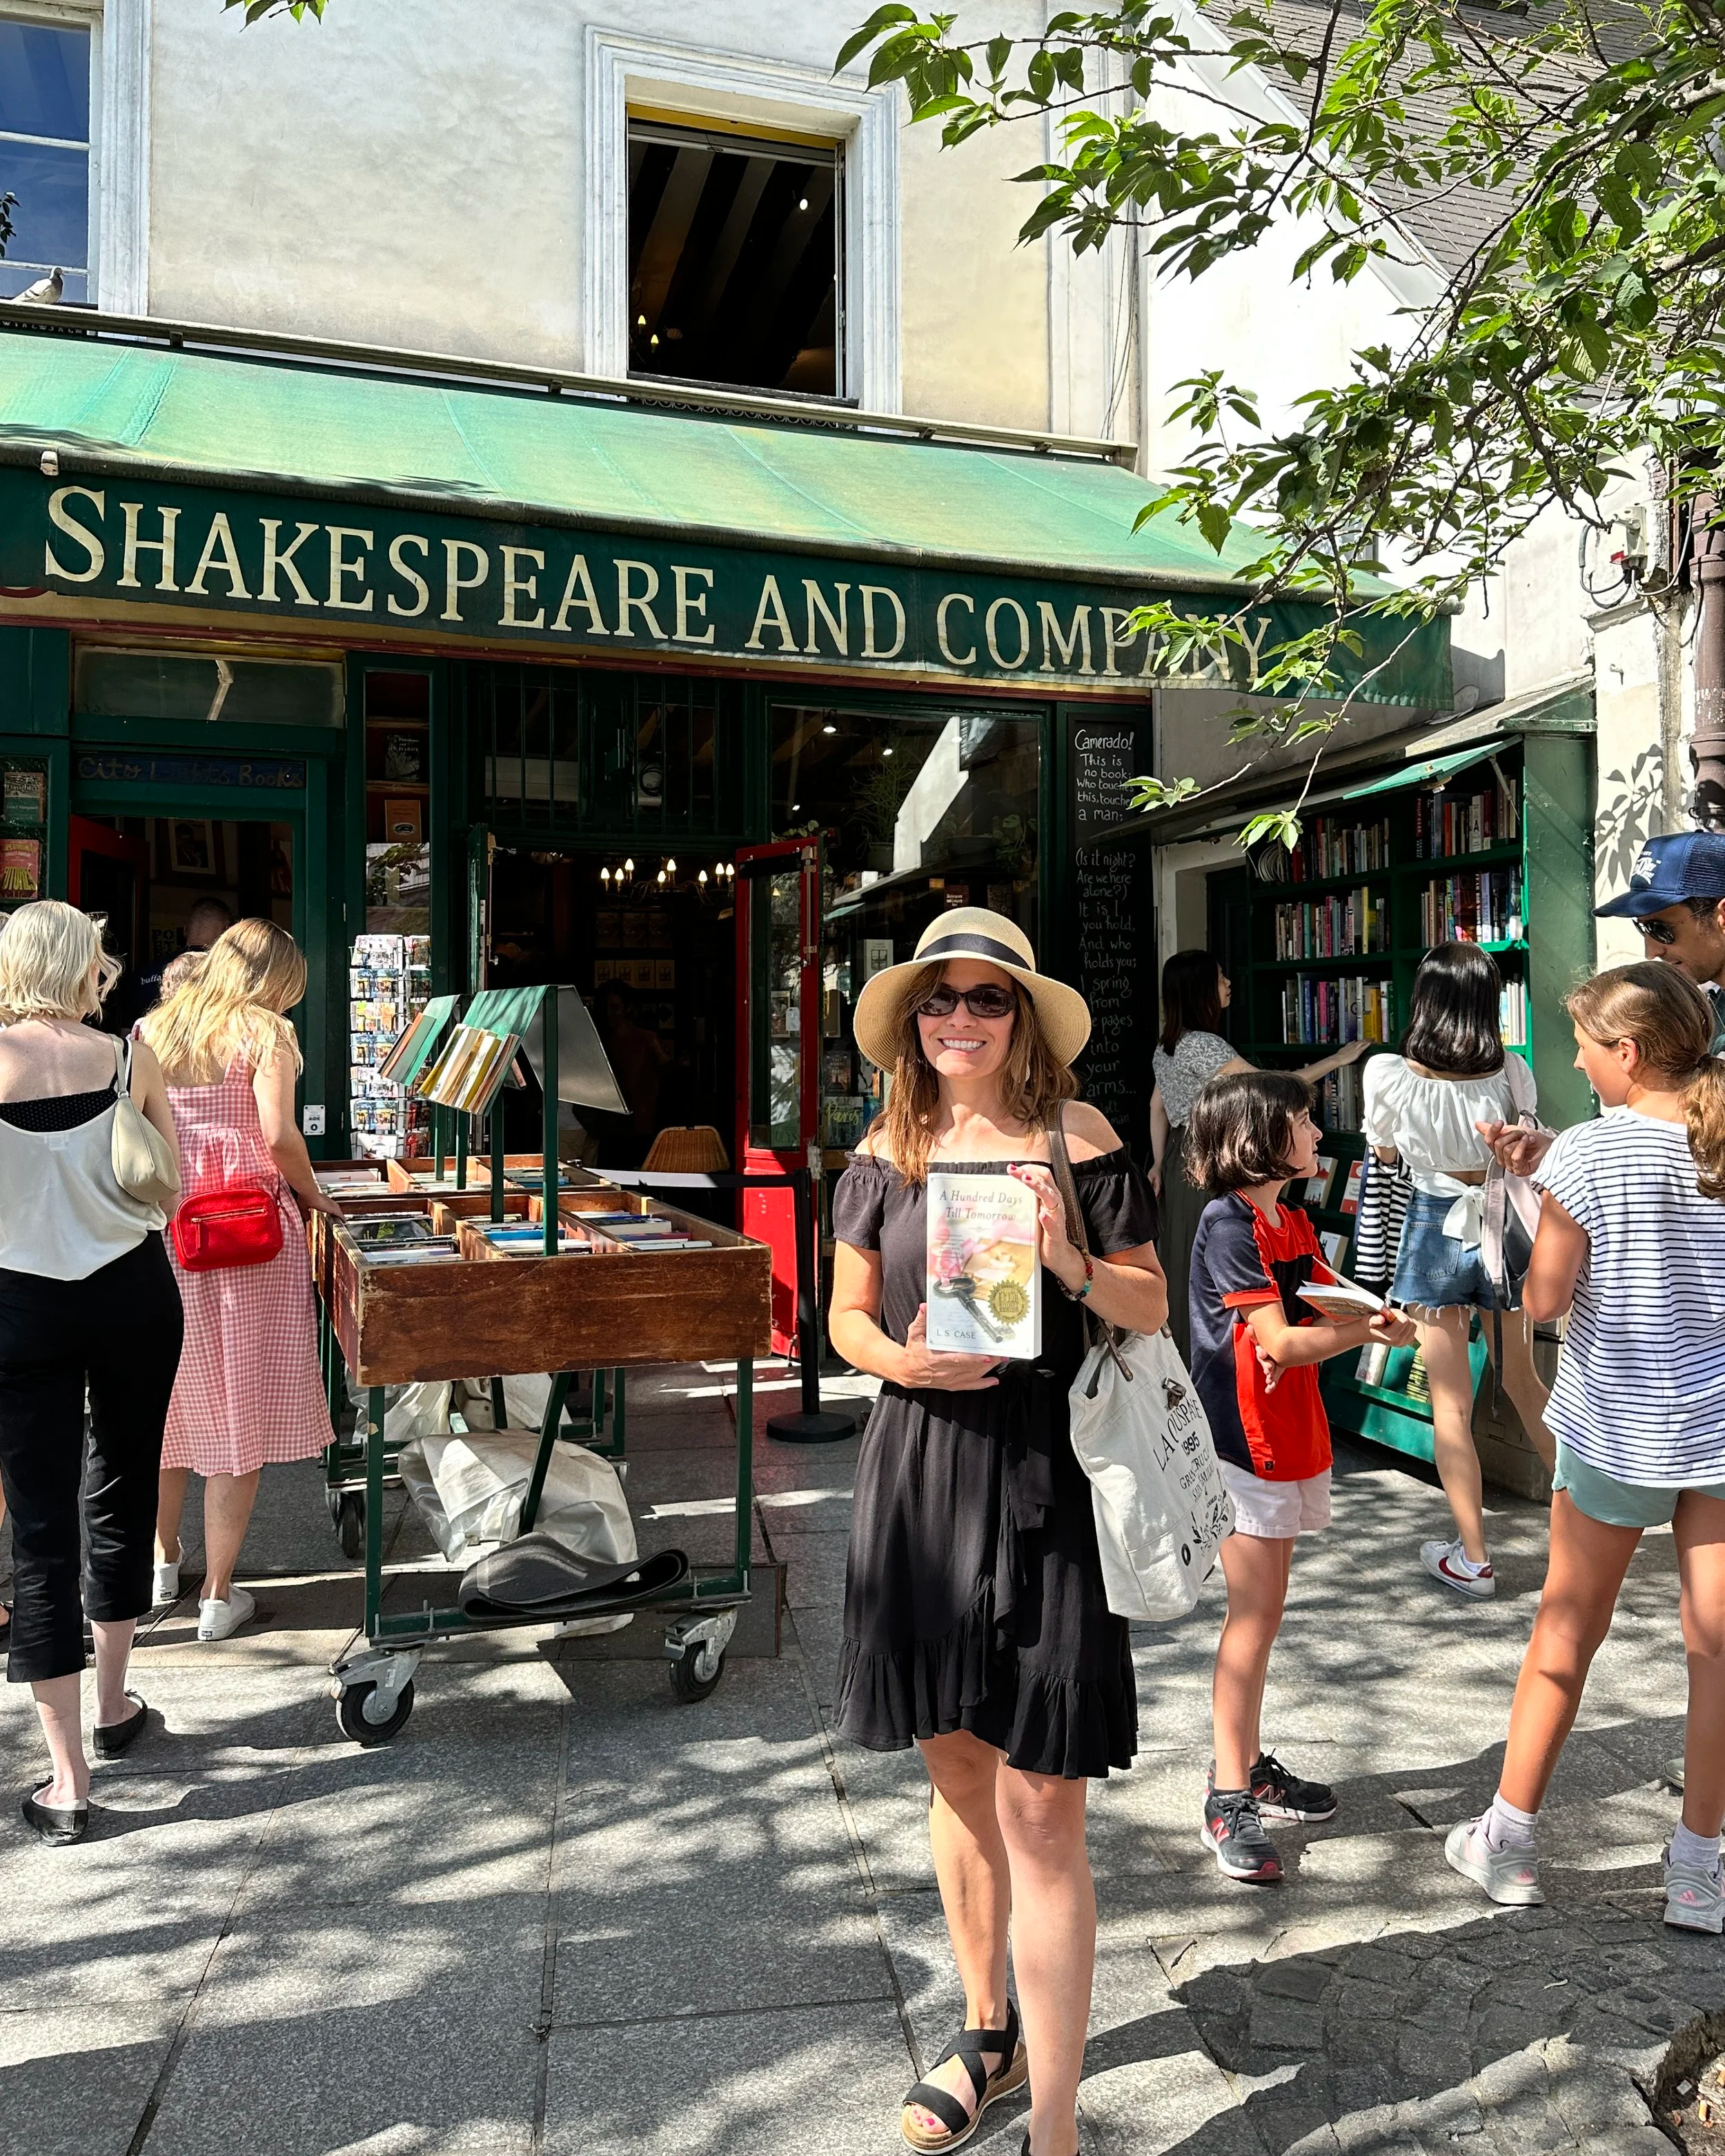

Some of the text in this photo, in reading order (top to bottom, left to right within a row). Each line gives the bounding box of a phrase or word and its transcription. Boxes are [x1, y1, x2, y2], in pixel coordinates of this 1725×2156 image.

[45, 485, 1272, 683] SHAKESPEARE AND COMPANY
[1074, 729, 1134, 750] Camerado!
[1080, 753, 1122, 766] This is
[1084, 769, 1097, 777] no
[1076, 778, 1096, 788] Who
[1100, 792, 1131, 806] touche
[1078, 808, 1087, 821] a
[1092, 849, 1100, 865] it
[1103, 852, 1136, 872] night?
[1076, 869, 1132, 884] Are we here
[1083, 885, 1127, 901] alone?)
[1079, 899, 1119, 917] It is I
[1082, 921, 1103, 935] you
[1078, 935, 1132, 950] And who
[1084, 952, 1114, 970] holds
[140, 974, 161, 985] buffa
[1092, 974, 1132, 999] spring
[1089, 992, 1120, 1013] from
[1101, 1015, 1133, 1035] pages
[1090, 1037, 1120, 1055] into
[1086, 1059, 1121, 1081] your
[825, 1101, 860, 1126] Paris
[940, 1190, 1023, 1207] A Hundred Days
[945, 1207, 1016, 1221] Till Tomorrow
[954, 1330, 976, 1340] CASE
[1181, 1431, 1200, 1458] 1995
